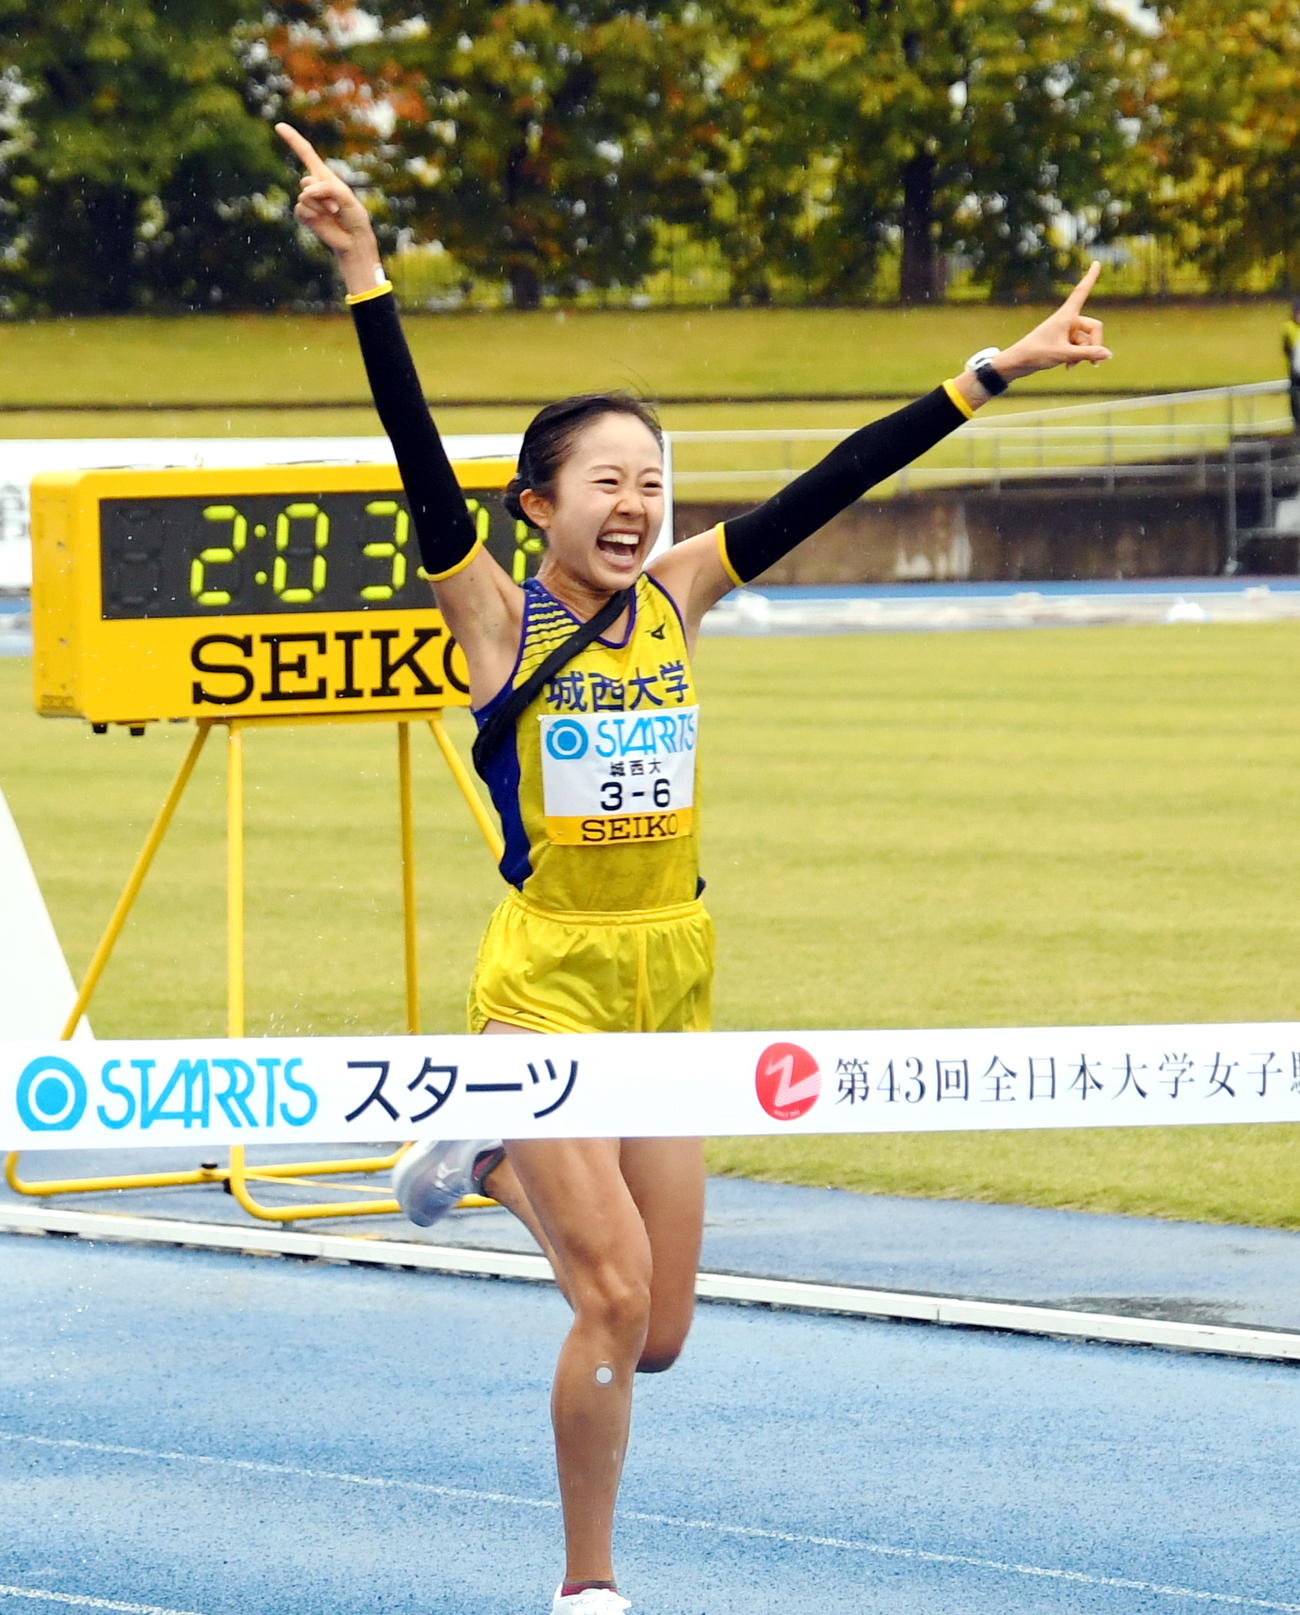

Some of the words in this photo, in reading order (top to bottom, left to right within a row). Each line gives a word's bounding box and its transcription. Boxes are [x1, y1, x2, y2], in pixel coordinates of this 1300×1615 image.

[546, 659, 689, 712] 城西大学
[595, 712, 695, 758] STARTS
[609, 758, 662, 777] 城西大
[600, 778, 671, 811] 3-6
[581, 813, 679, 842] SEIKO
[97, 1056, 319, 1130] STARTS
[344, 1055, 580, 1124] スターツ
